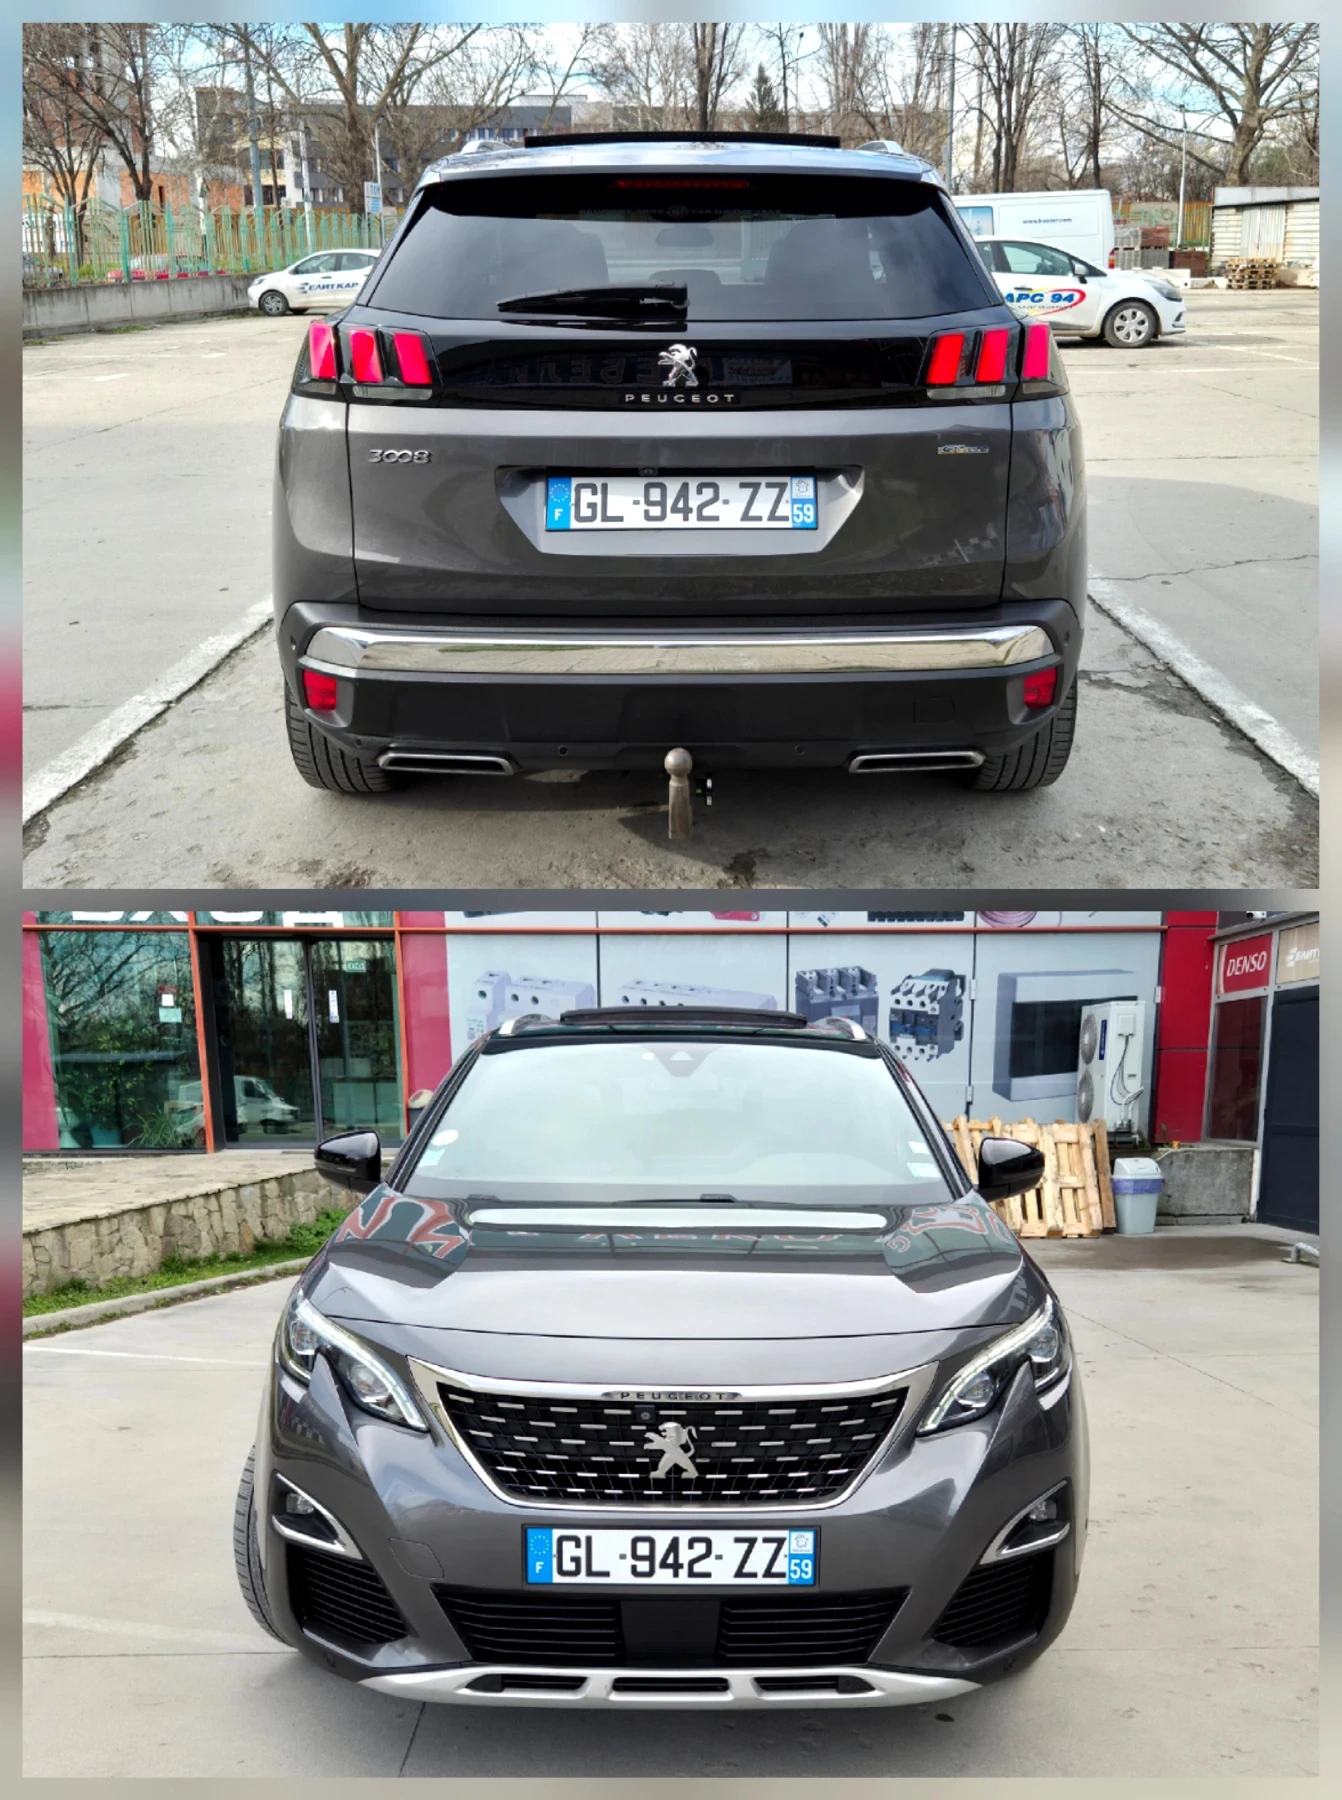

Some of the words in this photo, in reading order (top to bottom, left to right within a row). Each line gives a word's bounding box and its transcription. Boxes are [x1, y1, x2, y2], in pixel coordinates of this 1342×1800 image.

[1050, 293, 1075, 303] 94
[625, 393, 735, 403] PEUGEOT
[368, 449, 430, 464] 3008
[554, 508, 563, 521] F
[793, 503, 814, 523] 59
[1226, 951, 1267, 977] DENSO
[620, 1391, 726, 1400] PEUGEOT
[535, 1561, 544, 1574] F
[790, 1559, 812, 1579] 59
